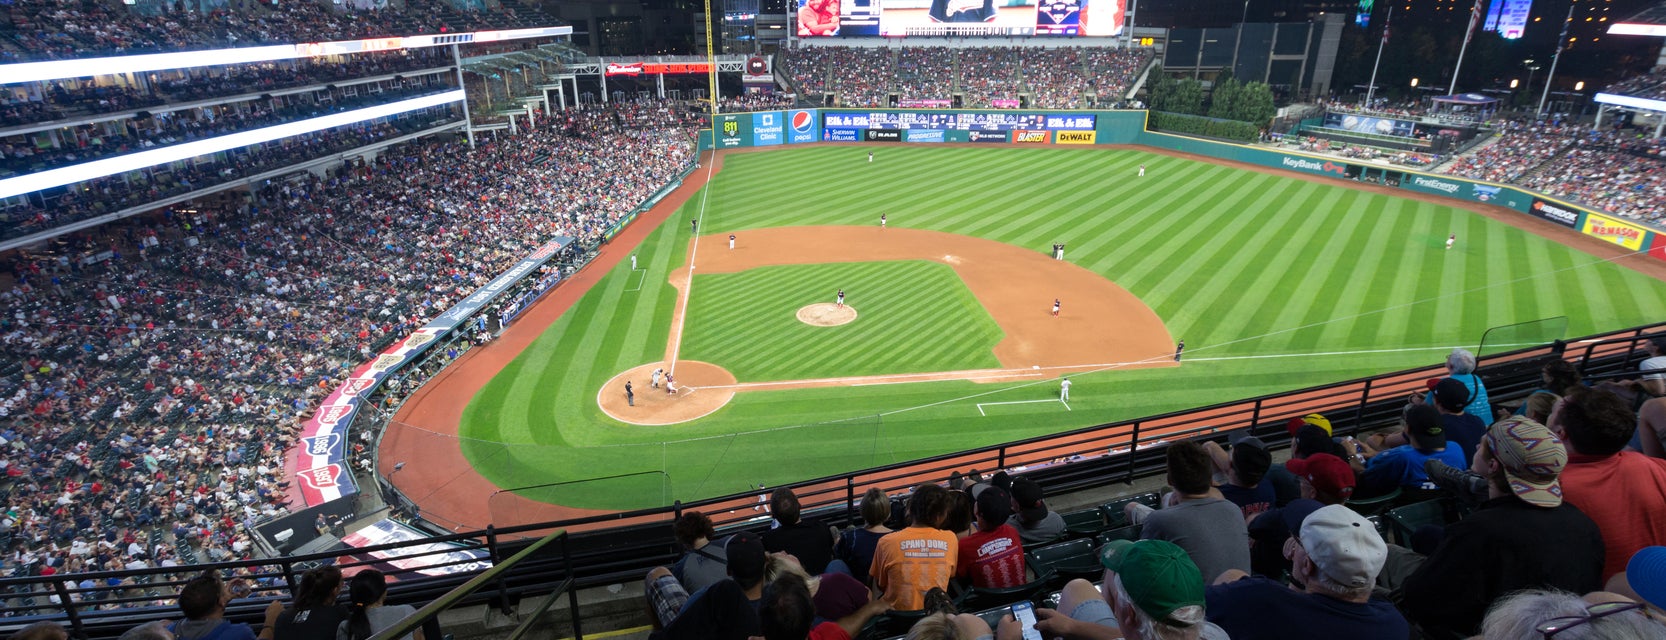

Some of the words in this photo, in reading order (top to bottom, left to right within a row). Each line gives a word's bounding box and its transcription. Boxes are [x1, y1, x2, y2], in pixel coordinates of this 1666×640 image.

[826, 116, 843, 126] Elk
[843, 117, 852, 126] &
[853, 116, 870, 126] Elk
[1047, 118, 1065, 128] Elk
[1065, 118, 1075, 128] &
[1075, 118, 1094, 128] Elk
[724, 121, 737, 132] 811
[754, 126, 782, 134] Cleveland
[794, 134, 811, 142] pepsi
[1283, 156, 1322, 171] KeyBank
[1415, 177, 1459, 193] FirstEnergy
[313, 466, 333, 486] 1997
